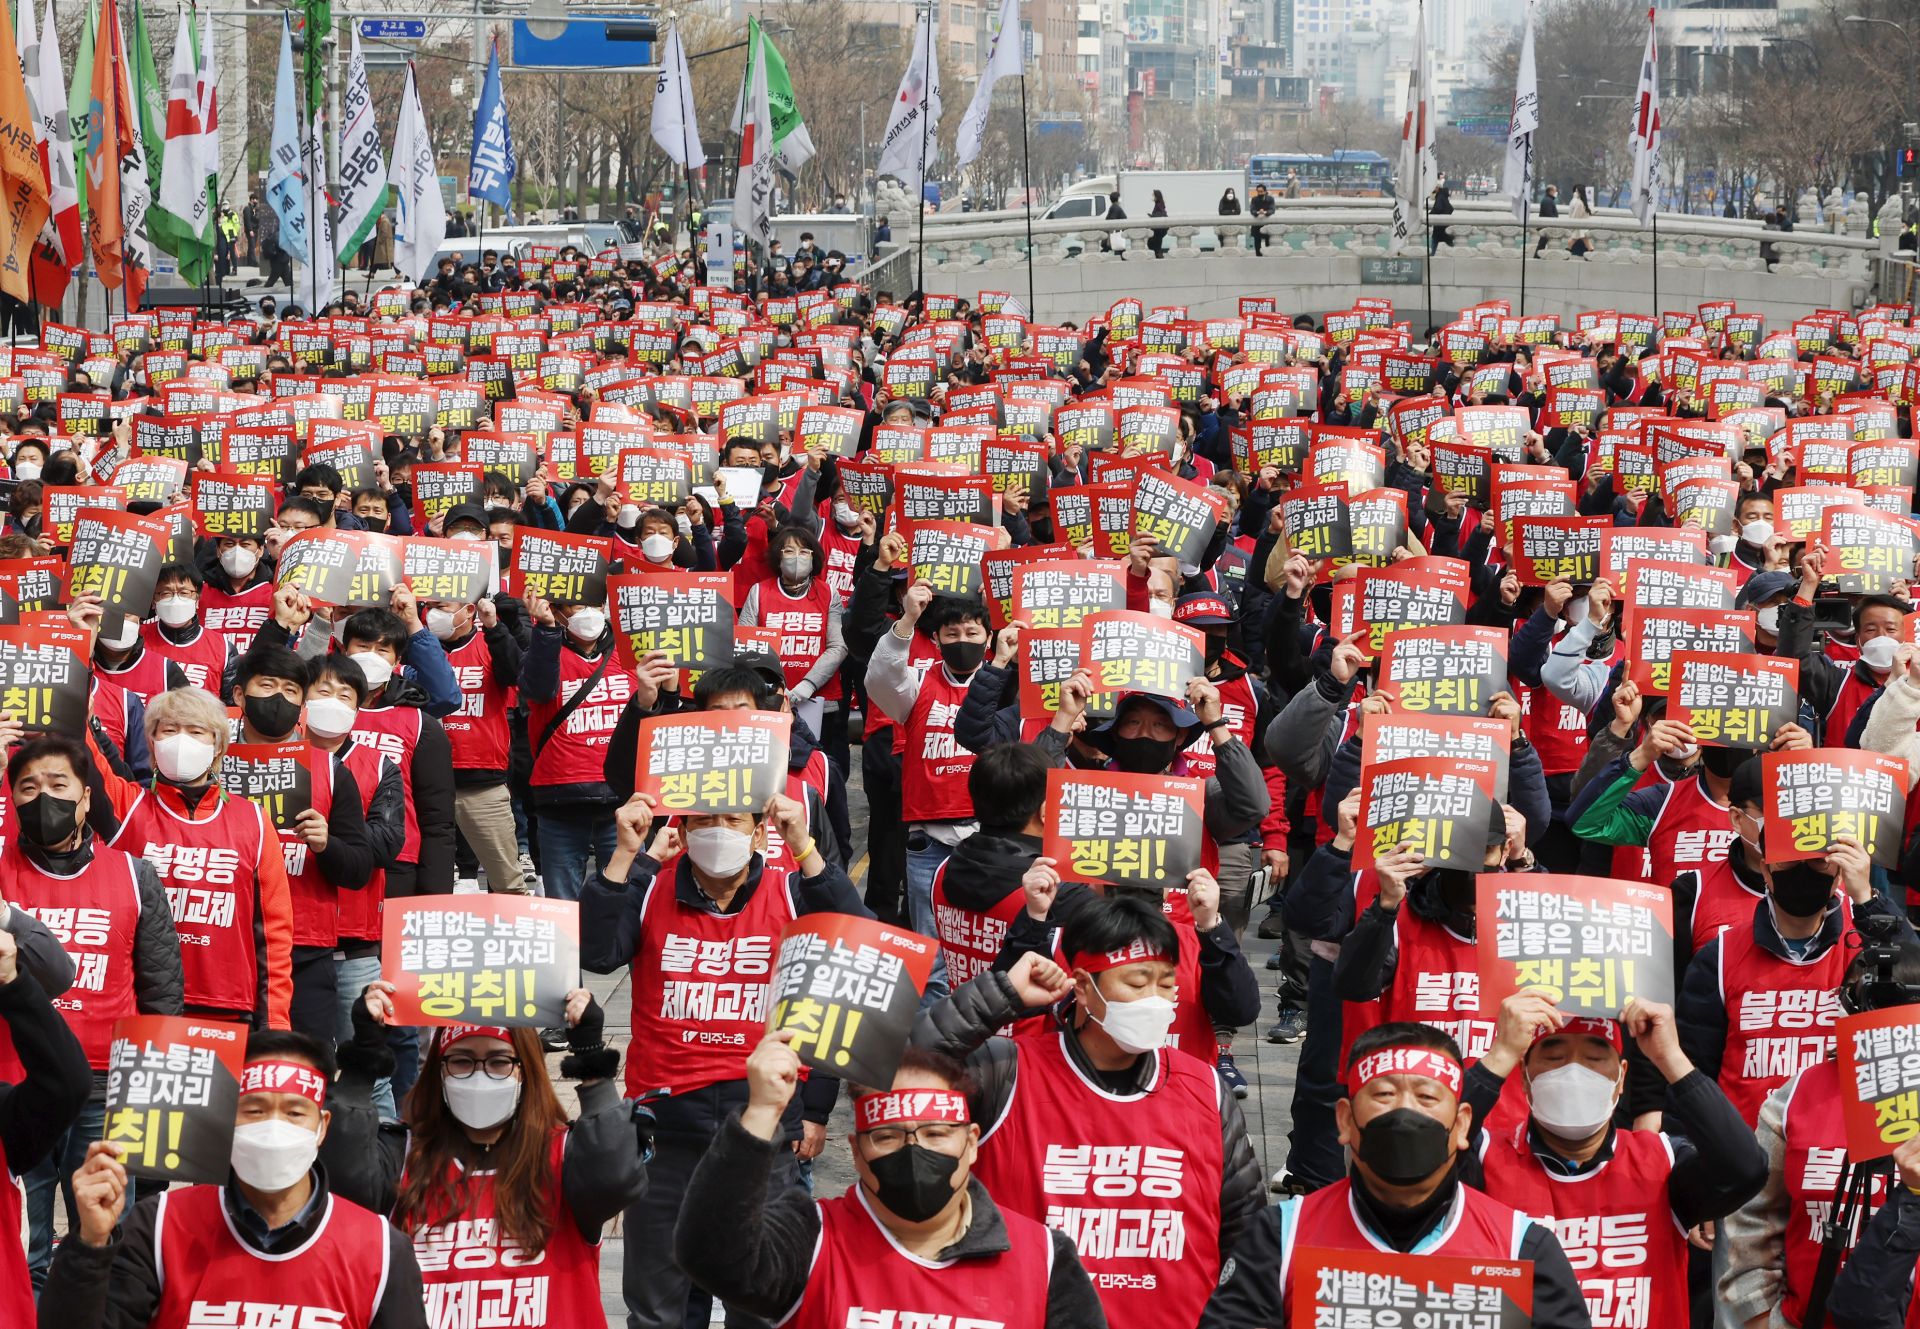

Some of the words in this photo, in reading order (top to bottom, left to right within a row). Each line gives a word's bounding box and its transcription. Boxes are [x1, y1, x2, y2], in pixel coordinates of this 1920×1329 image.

[715, 233, 721, 247] 1
[1370, 261, 1413, 274] 모전교
[374, 403, 399, 414] 질좋은
[402, 403, 429, 413] 일자리
[375, 392, 400, 403] 차별없는
[404, 393, 429, 403] 노동권
[379, 416, 422, 434] 쟁취!
[1851, 458, 1875, 474] 질좋은
[1879, 455, 1909, 467] 일자리
[1852, 447, 1880, 460] 차별없는
[1883, 449, 1909, 458] 노동권
[197, 479, 233, 495] 차별없는
[237, 481, 266, 496] 노동권
[1139, 472, 1176, 499] 차별없는
[1178, 492, 1212, 516] 노동권
[197, 493, 228, 510] 질좋은
[233, 495, 266, 508] 일자리
[1134, 493, 1165, 516] 질좋은
[1167, 506, 1204, 530] 일자리
[204, 512, 257, 535] 쟁취!
[1830, 512, 1877, 530] 차별없는
[1880, 519, 1912, 536] 노동권
[520, 534, 562, 556] 차별없는
[566, 542, 599, 559] 노동권
[1830, 528, 1871, 546] 질좋은
[1875, 533, 1913, 547] 일자리
[518, 551, 555, 573] 질좋은
[559, 556, 597, 574] 일자리
[1840, 548, 1903, 573] 쟁취!
[617, 586, 669, 606] 차별없는
[673, 588, 717, 605] 노동권
[204, 607, 270, 630] 불평등
[619, 607, 661, 632] 질좋은
[667, 605, 716, 624] 일자리
[766, 612, 822, 633] 불평등
[1176, 603, 1197, 618] 단결
[1208, 602, 1228, 616] 투쟁
[630, 628, 703, 664] 쟁취!
[1093, 621, 1147, 640] 차별없는
[1151, 630, 1191, 650] 노동권
[1392, 639, 1445, 658] 차별없는
[1450, 641, 1493, 657] 노동권
[22, 644, 70, 664] 노동권
[1090, 639, 1138, 660] 질좋은
[1145, 641, 1191, 664] 일자리
[14, 664, 69, 684] 일자리
[1100, 659, 1178, 692] 쟁취!
[1390, 658, 1438, 680] 질좋은
[1443, 658, 1492, 676] 일자리
[1681, 661, 1738, 684] 차별없는
[1741, 670, 1784, 687] 노동권
[1400, 679, 1478, 712] 쟁취!
[1679, 683, 1729, 707] 질좋은
[1734, 687, 1783, 707] 일자리
[651, 726, 715, 745] 차별없는
[720, 726, 771, 745] 노동권
[1689, 709, 1769, 743] 쟁취!
[253, 757, 296, 773] 노동권
[649, 746, 706, 775] 질좋은
[712, 745, 769, 766] 일자리
[248, 774, 296, 792] 일자리
[659, 768, 753, 808] 쟁취!
[1370, 772, 1420, 798] 차별없는
[1424, 773, 1474, 796] 노동권
[1776, 763, 1843, 787] 차별없는
[1848, 767, 1893, 792] 노동권
[1059, 782, 1128, 810] 차별없는
[1132, 792, 1185, 813] 노동권
[1367, 797, 1409, 826] 질좋은
[1414, 793, 1472, 817] 일자리
[1777, 787, 1833, 818] 질좋은
[1839, 785, 1892, 813] 일자리
[1058, 809, 1117, 837] 질좋은
[1125, 812, 1183, 836] 일자리
[1070, 839, 1167, 880] 쟁취!
[1495, 889, 1584, 922] 차별없는
[1590, 897, 1653, 930] 노동권
[401, 911, 486, 938] 차별없는
[492, 918, 556, 942] 노동권
[1495, 922, 1573, 957] 질좋은
[1581, 926, 1653, 956] 일자리
[400, 940, 475, 971] 질좋은
[483, 941, 555, 967] 일자리
[661, 933, 772, 976] 불평등
[830, 942, 904, 978] 노동권
[417, 970, 537, 1018] 쟁취!
[813, 965, 895, 1012] 일자리
[1514, 958, 1636, 1008] 쟁취!
[661, 980, 769, 1022] 체제교체
[142, 1040, 215, 1076] 노동권
[1358, 1050, 1393, 1084] 단결
[1426, 1052, 1461, 1092] 투쟁
[128, 1071, 211, 1107] 일자리
[295, 1068, 323, 1102] 투쟁
[864, 1098, 901, 1123] 단결
[933, 1096, 965, 1121] 투쟁
[1043, 1144, 1185, 1199] 불평등
[1315, 1266, 1418, 1306] 차별없는
[1427, 1280, 1502, 1312] 노동권
